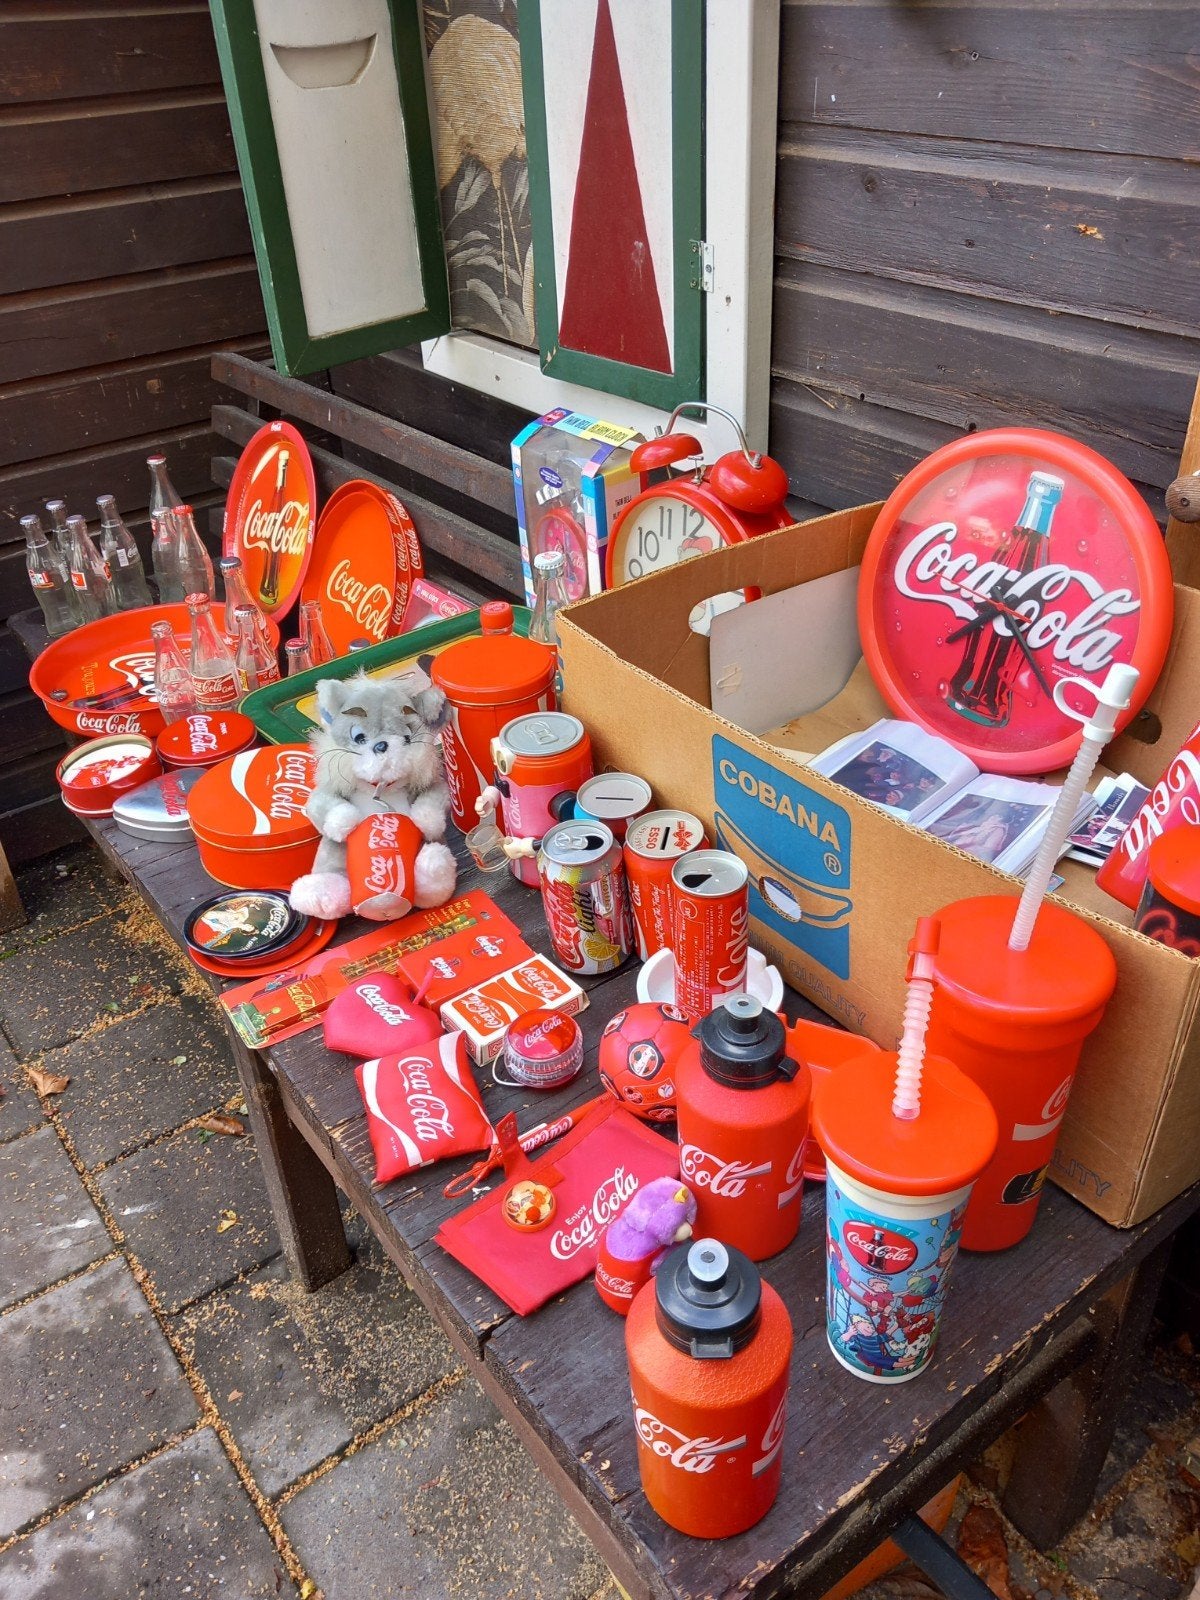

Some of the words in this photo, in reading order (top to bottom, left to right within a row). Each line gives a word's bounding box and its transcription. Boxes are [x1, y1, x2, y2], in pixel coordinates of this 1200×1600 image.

[658, 505, 673, 540] 11
[682, 504, 704, 539] 12
[638, 526, 660, 562] 10
[894, 521, 1141, 672] Coca-Cola
[76, 711, 141, 735] Coca-Cola
[719, 758, 841, 853] COBANA
[646, 827, 660, 850] ESSO
[573, 889, 602, 932] light
[717, 906, 748, 987] Coke
[354, 984, 416, 1026] Coca-Cola
[788, 958, 868, 1027] QUALITY
[524, 1014, 563, 1048] Coca-Cola
[397, 1056, 456, 1142] Coca-Cola
[1051, 1149, 1112, 1198] LITY
[550, 1165, 639, 1260] Coca-Cola
[564, 1204, 587, 1226] Enjoy
[846, 1229, 914, 1262] Coca-Cola
[596, 1262, 636, 1295] Coca-Cola
